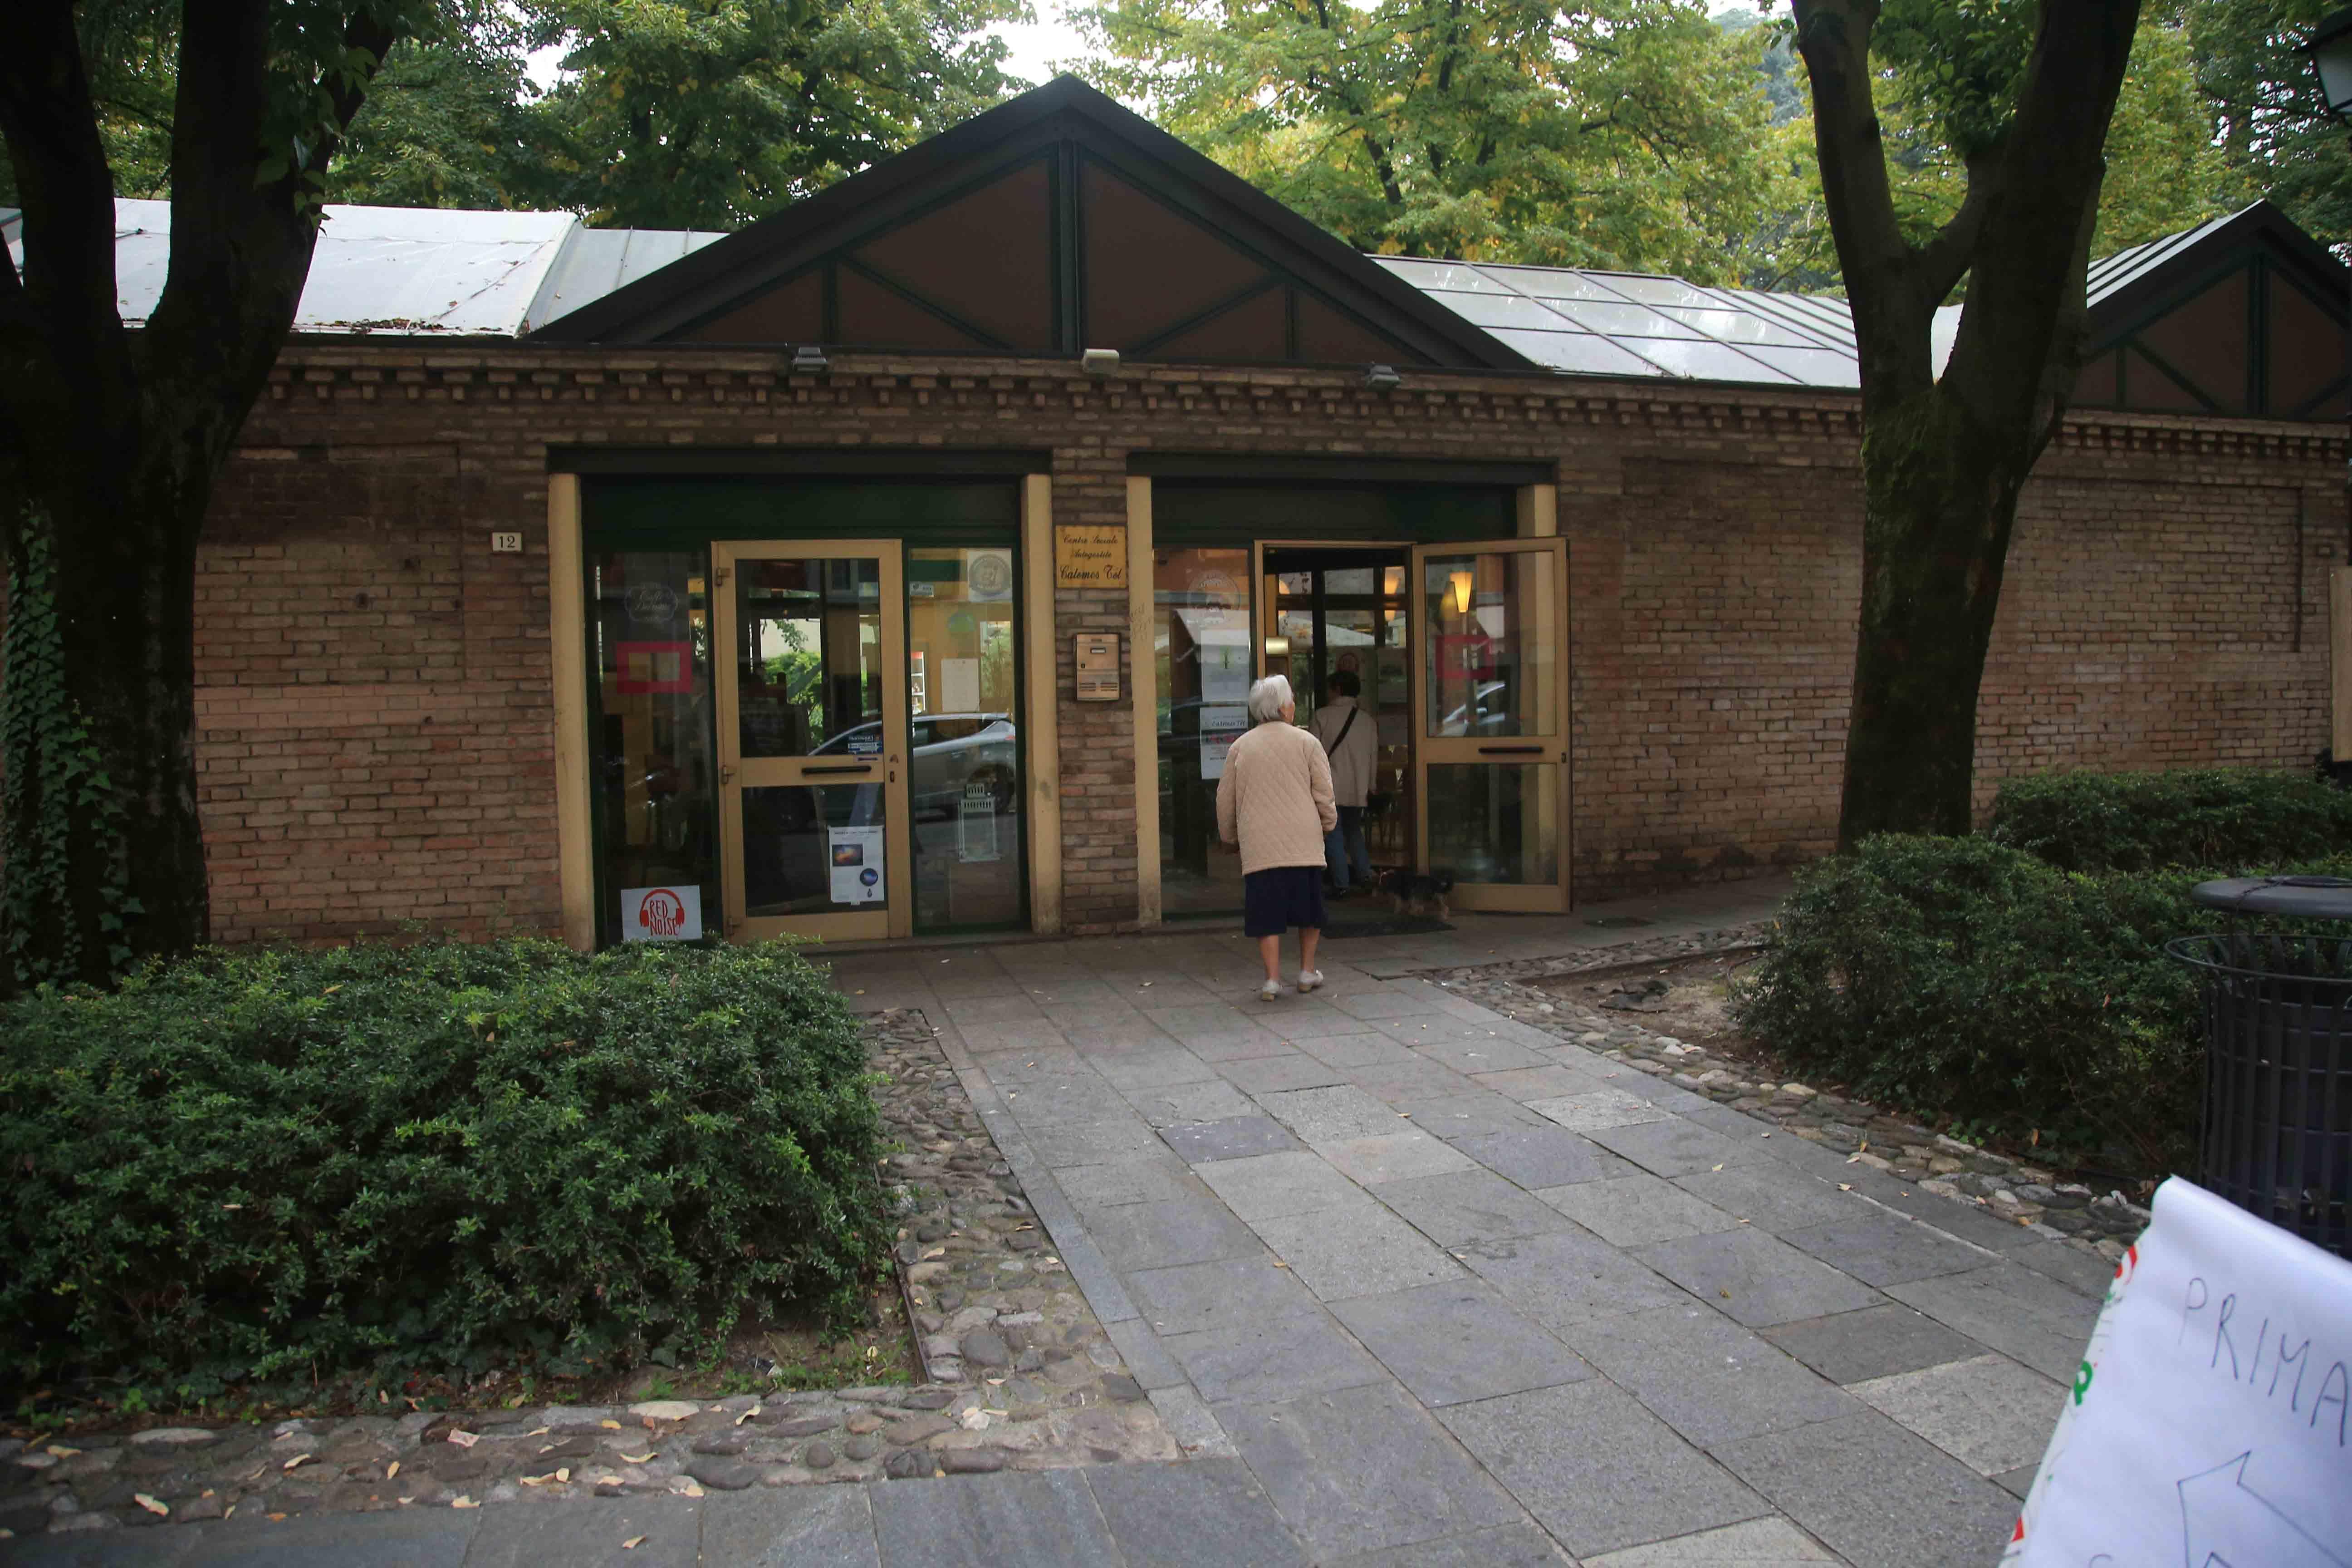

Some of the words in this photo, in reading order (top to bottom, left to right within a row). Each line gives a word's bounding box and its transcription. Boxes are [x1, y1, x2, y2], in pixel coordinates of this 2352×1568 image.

[500, 536, 515, 548] 12
[1063, 534, 1088, 544] Centro
[650, 900, 668, 918] RED
[650, 916, 679, 936] NOISE
[2178, 1276, 2348, 1448] PRIMA
